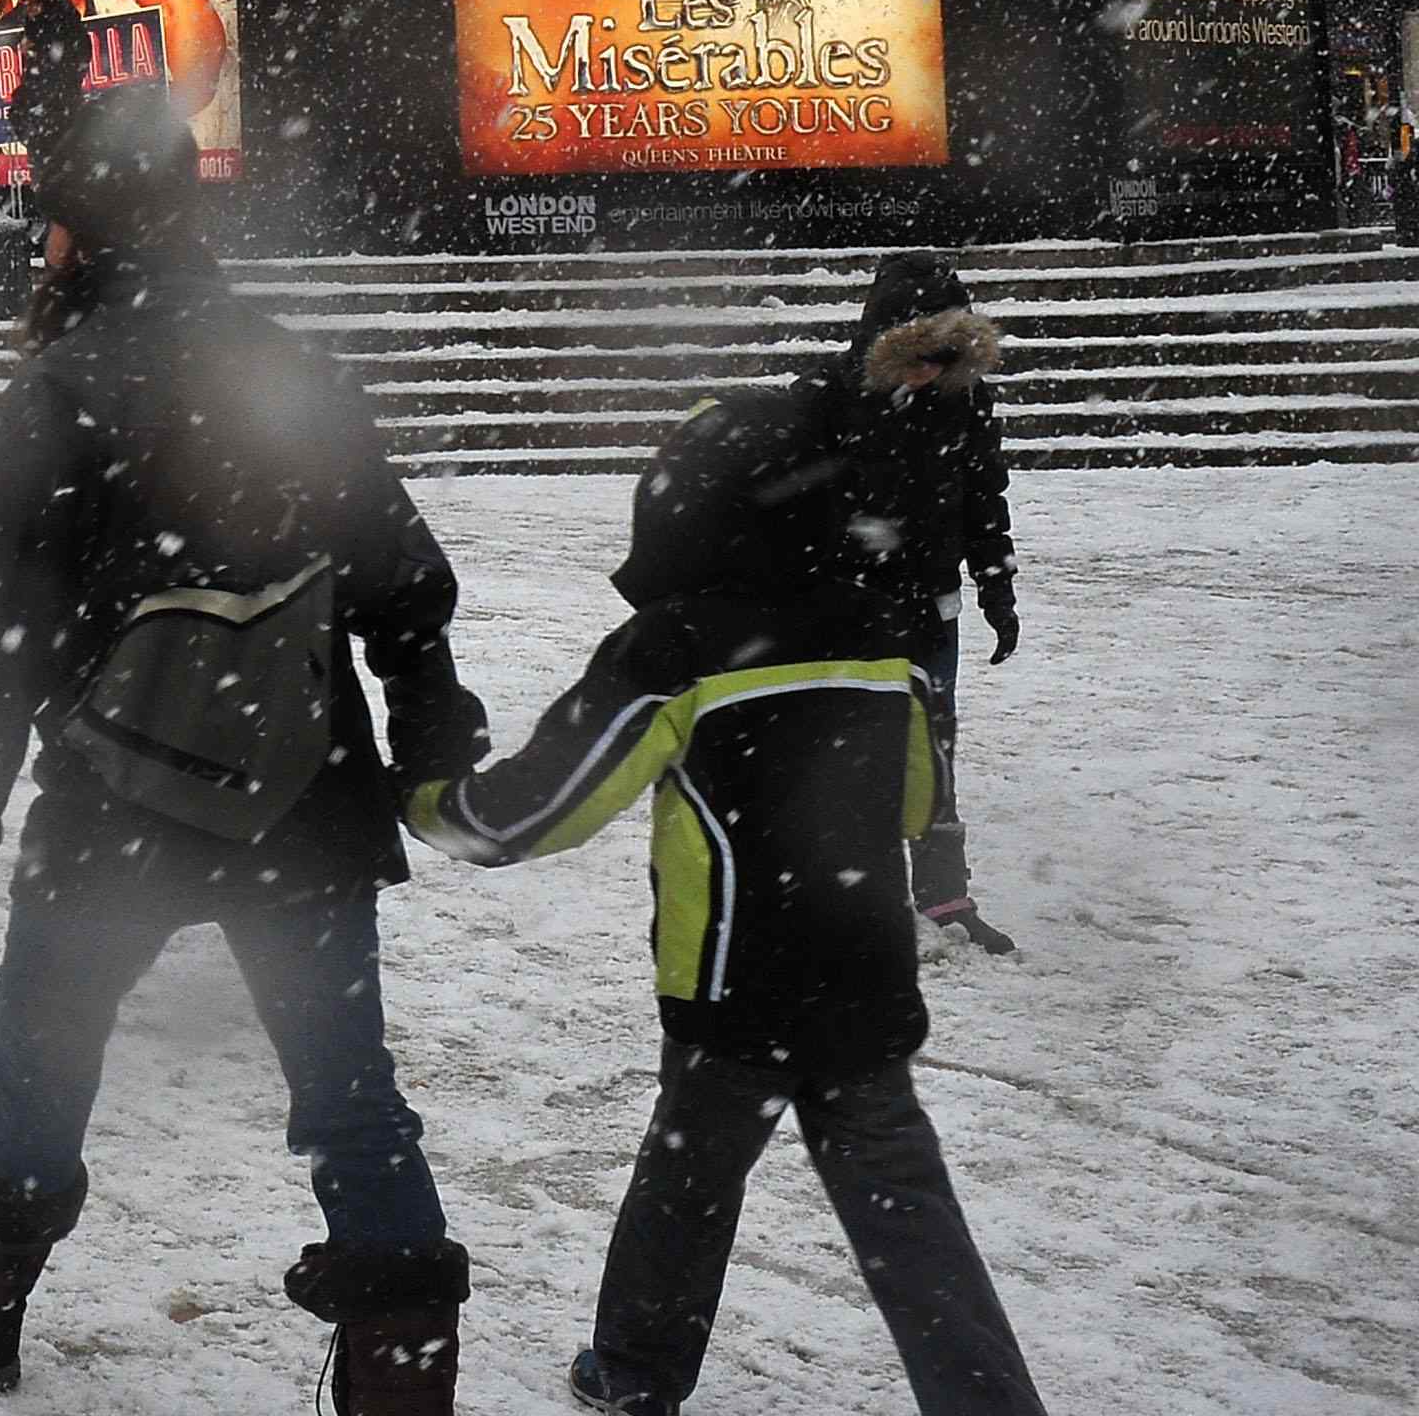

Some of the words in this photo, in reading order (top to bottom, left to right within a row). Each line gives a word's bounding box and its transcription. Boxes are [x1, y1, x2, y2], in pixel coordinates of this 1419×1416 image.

[1138, 15, 1187, 42] around
[1191, 15, 1250, 45] London's
[501, 6, 892, 97] Misérables
[509, 103, 559, 142] 25
[570, 99, 709, 141] YEARS
[719, 95, 892, 137] YOUNG
[622, 145, 701, 166] QUEEN'S
[707, 144, 789, 163] THEATRE
[484, 194, 597, 216] LONDON
[610, 202, 744, 224] entertainment
[750, 201, 781, 222] like
[880, 197, 921, 217] else
